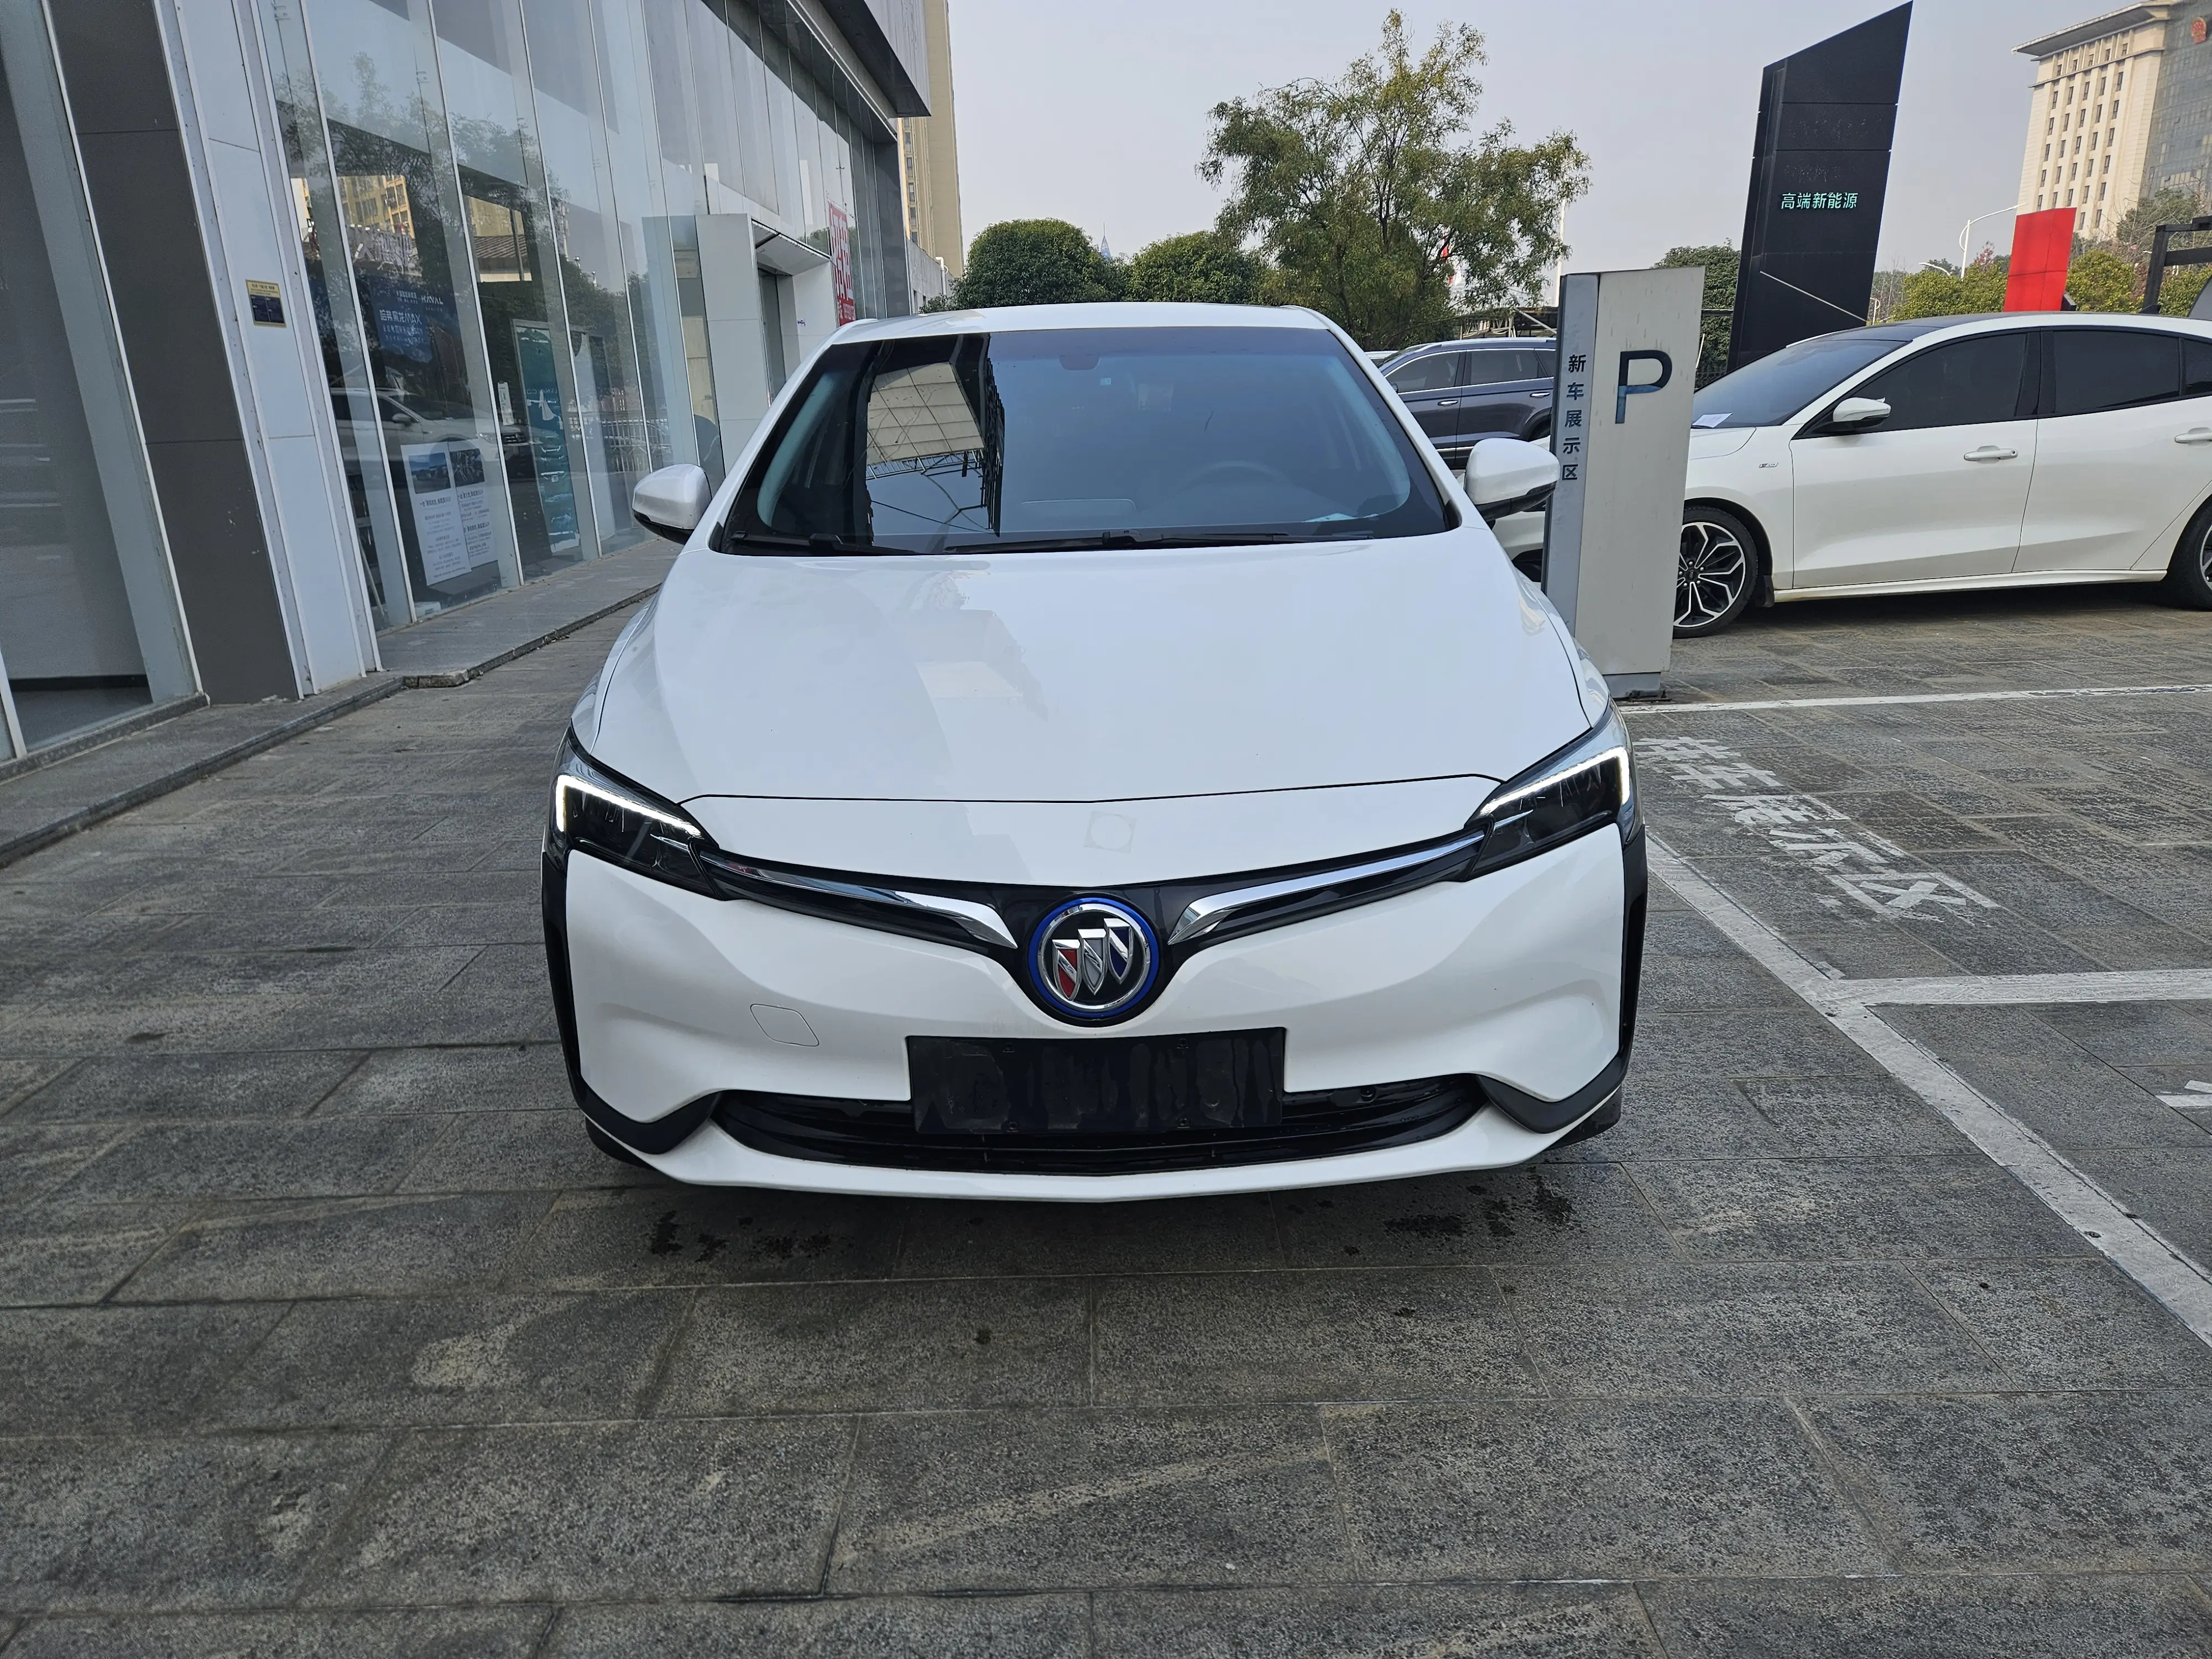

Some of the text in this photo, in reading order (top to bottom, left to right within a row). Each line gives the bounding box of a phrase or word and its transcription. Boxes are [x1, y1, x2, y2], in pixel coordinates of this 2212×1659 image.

[1781, 192, 1858, 210] 高端新能源
[421, 294, 444, 305] HAVAL
[1615, 350, 1673, 424] P
[1562, 354, 1587, 481] 新车展示区
